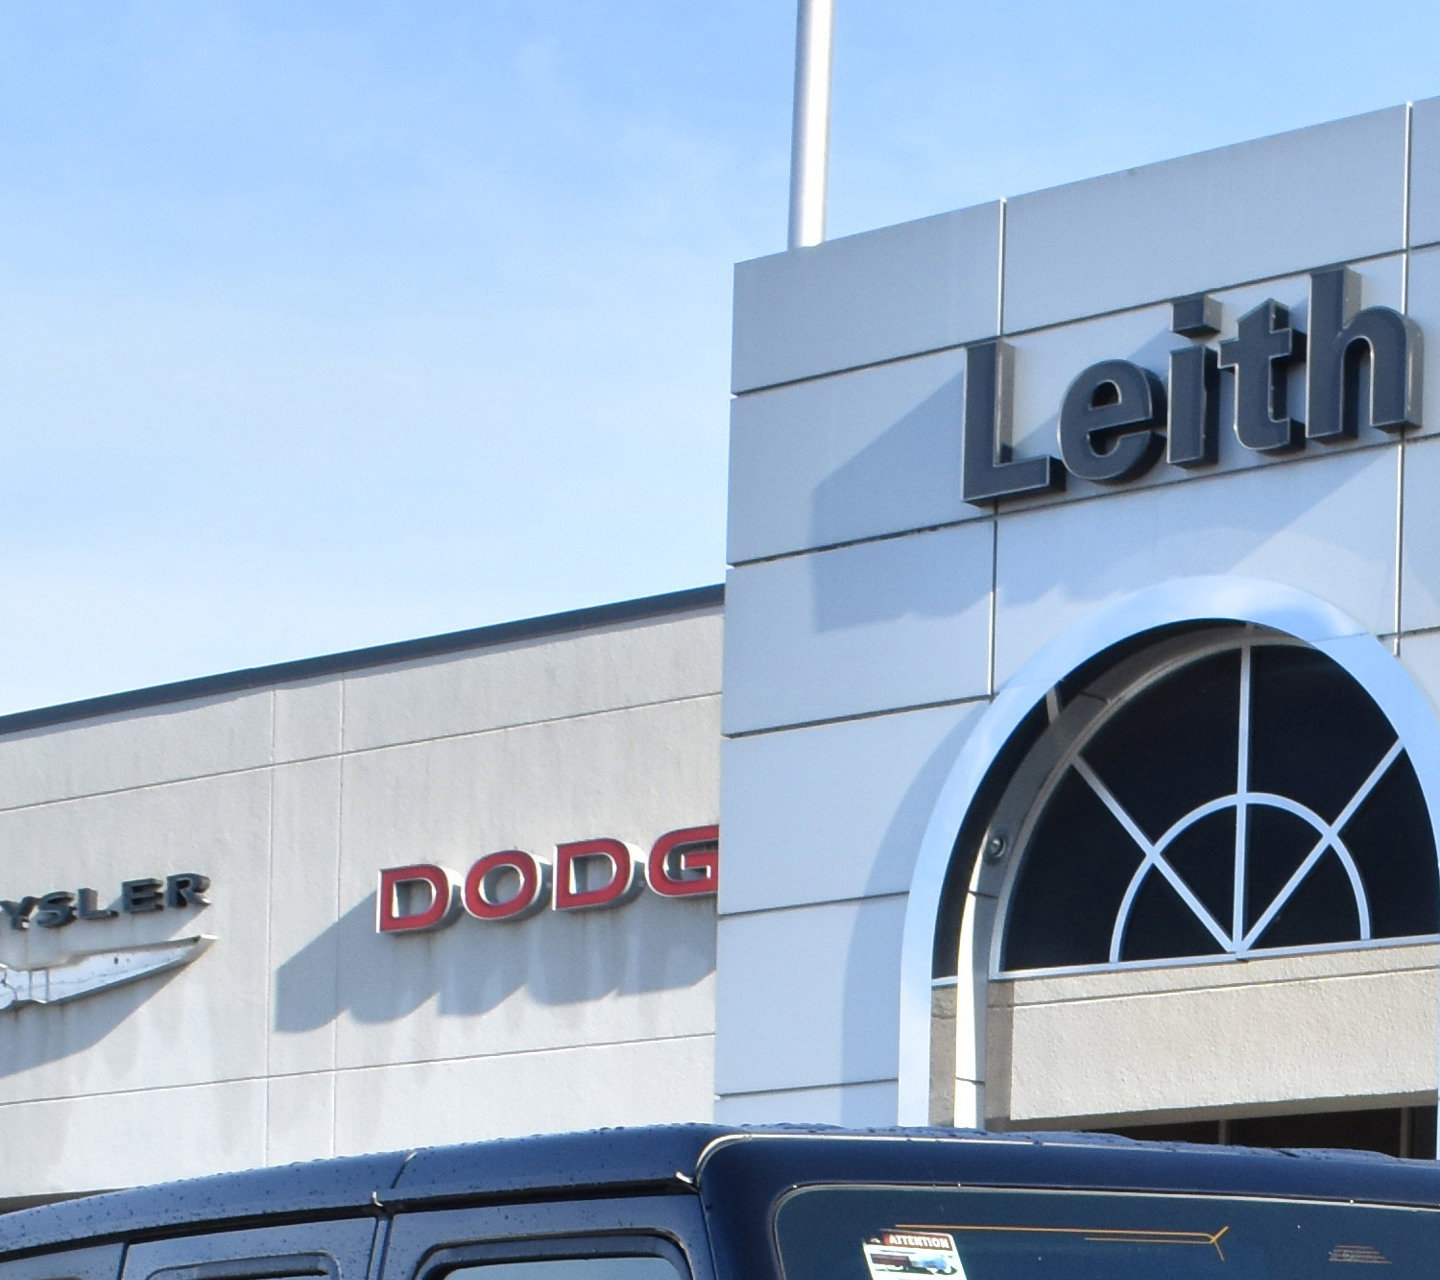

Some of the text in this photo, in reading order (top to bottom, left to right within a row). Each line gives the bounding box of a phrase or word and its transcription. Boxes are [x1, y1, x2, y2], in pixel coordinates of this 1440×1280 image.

[961, 266, 1423, 508] Leith
[374, 824, 720, 935] DODG
[888, 1234, 951, 1249] ATTENTION
